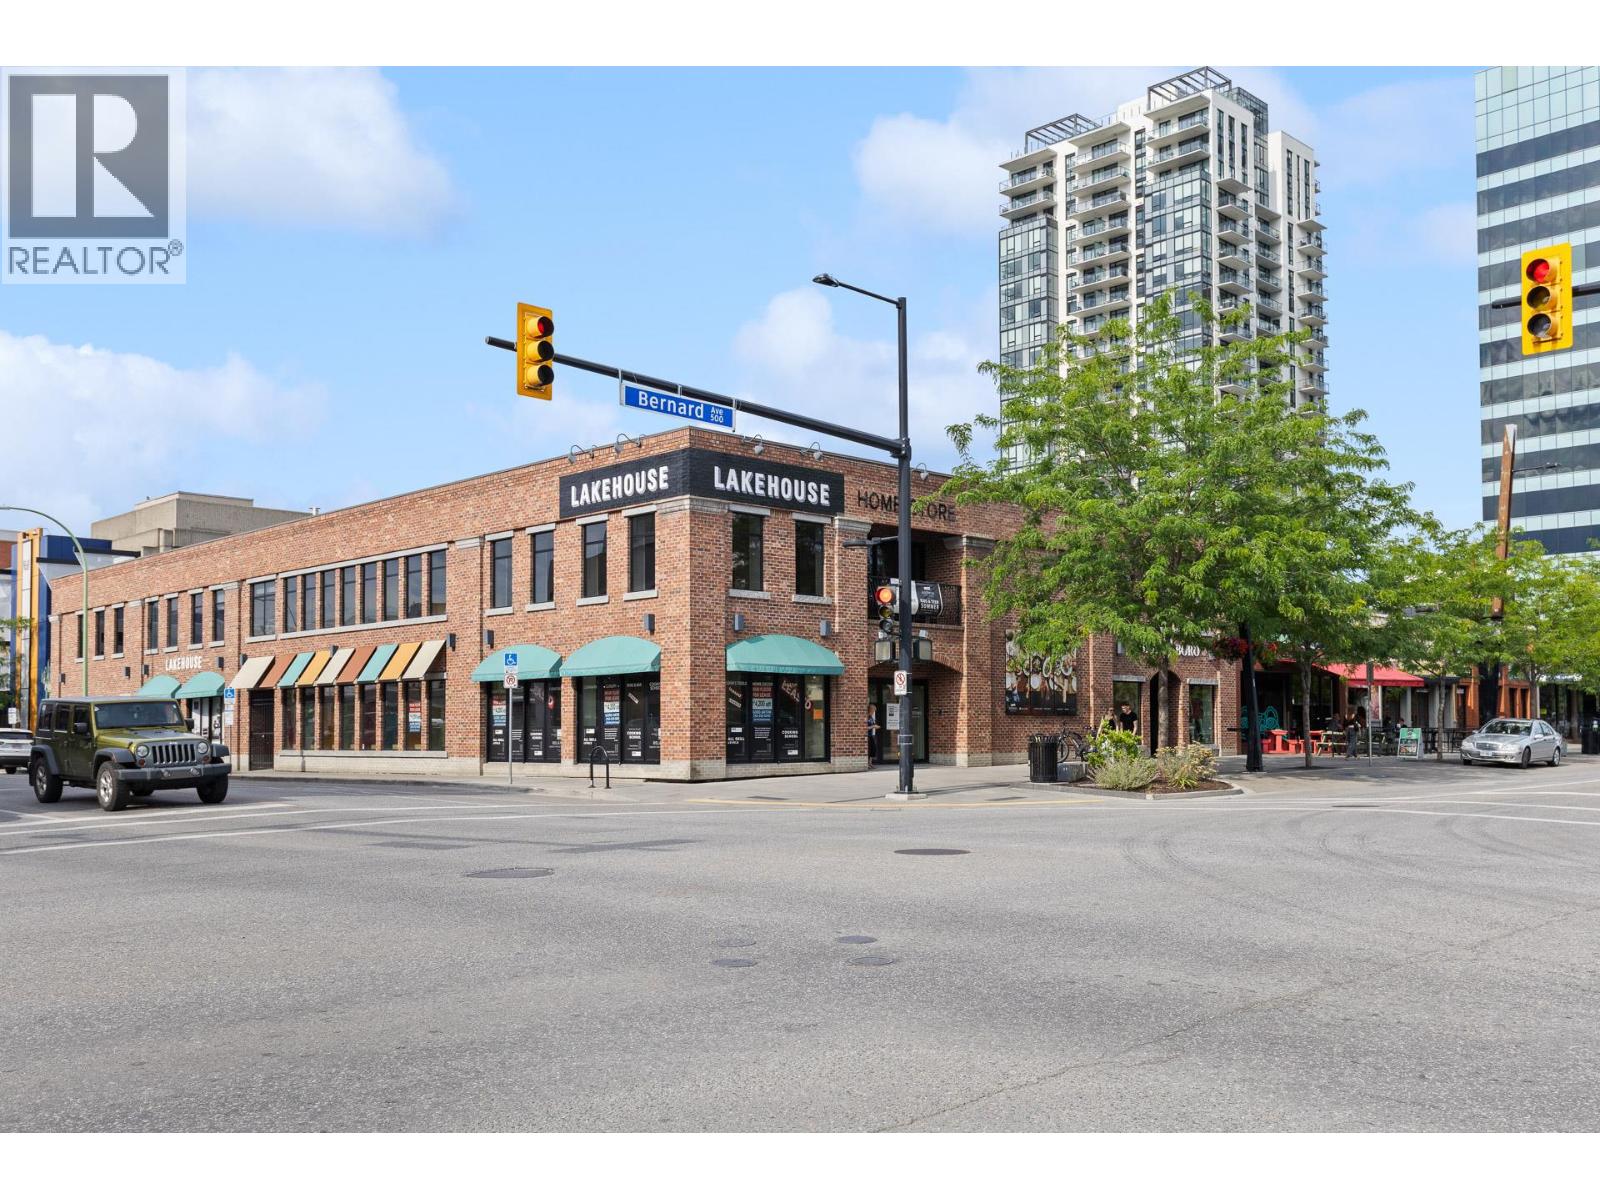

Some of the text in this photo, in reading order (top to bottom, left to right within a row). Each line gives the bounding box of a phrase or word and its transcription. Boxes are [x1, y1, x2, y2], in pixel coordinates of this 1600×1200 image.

[638, 390, 704, 419] Bernard
[710, 405, 724, 416] Ave
[710, 415, 724, 424] 500
[570, 465, 670, 508] LAKEHOUSE
[713, 465, 831, 507] LAKEHOUSE
[910, 497, 957, 522] ORE
[165, 655, 202, 671] LAKEHOUSE
